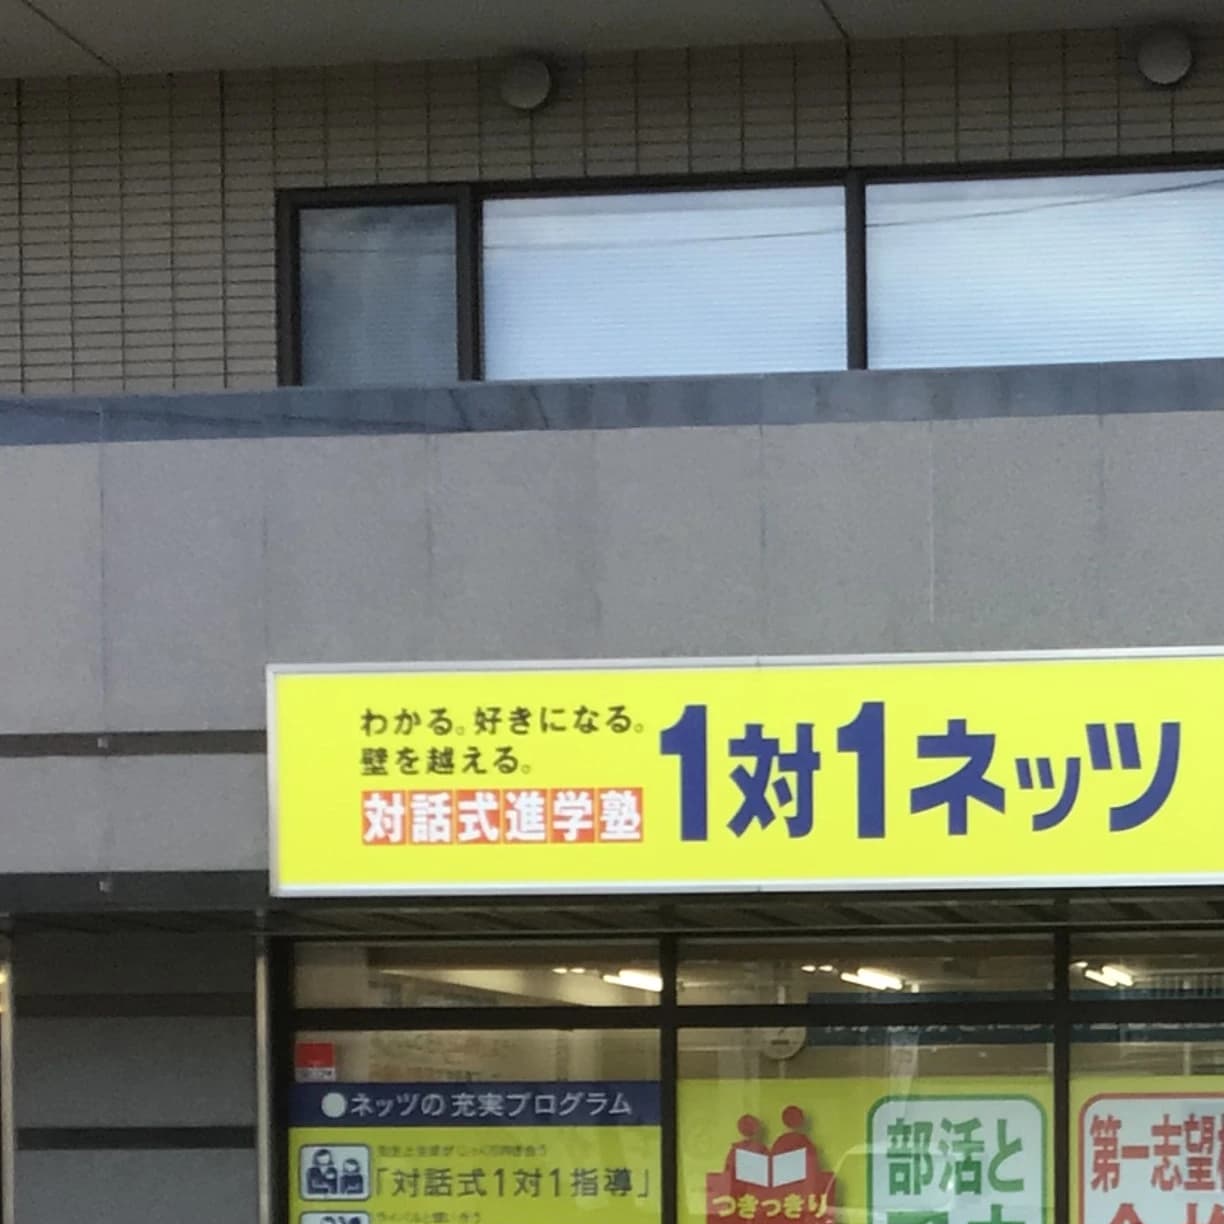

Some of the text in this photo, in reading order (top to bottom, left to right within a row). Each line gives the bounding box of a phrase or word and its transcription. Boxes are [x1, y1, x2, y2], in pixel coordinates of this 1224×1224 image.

[361, 704, 644, 737] わかる。好きになる。
[361, 746, 532, 776] 壁を越える。
[659, 700, 1181, 842] 1対1ネッツ
[362, 790, 642, 843] 対話式進学塾
[350, 1091, 633, 1118] ネッツの充実プログラム
[886, 1117, 1025, 1195] 部活と
[376, 1167, 650, 1199] 「対話式1対1指導」
[711, 1194, 828, 1220] つきっきり
